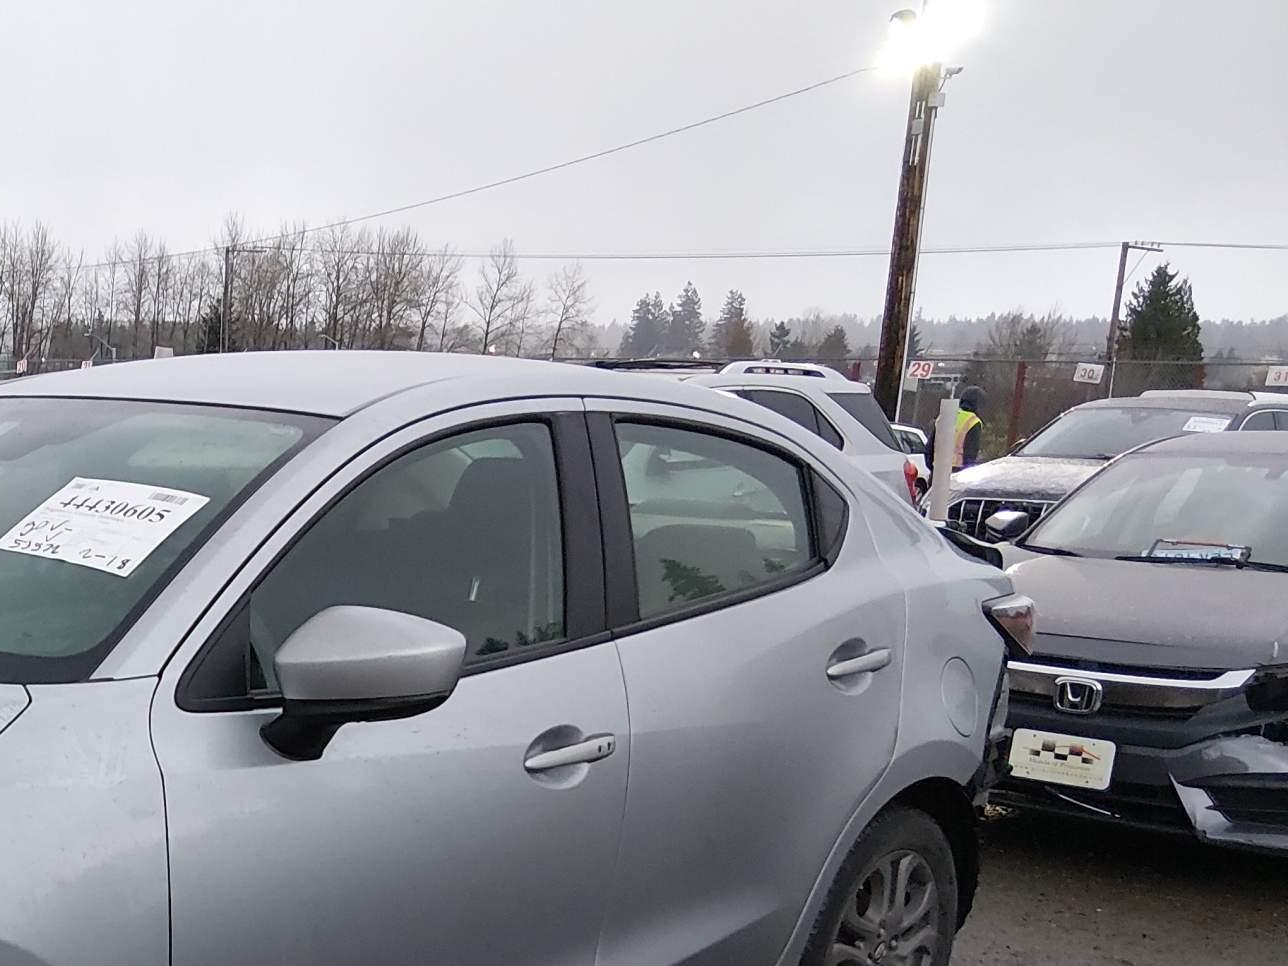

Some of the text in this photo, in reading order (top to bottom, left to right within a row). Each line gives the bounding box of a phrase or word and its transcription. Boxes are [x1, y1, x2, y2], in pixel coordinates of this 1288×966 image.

[910, 362, 931, 378] 29
[1081, 367, 1095, 379] 30
[60, 495, 172, 523] 44430605
